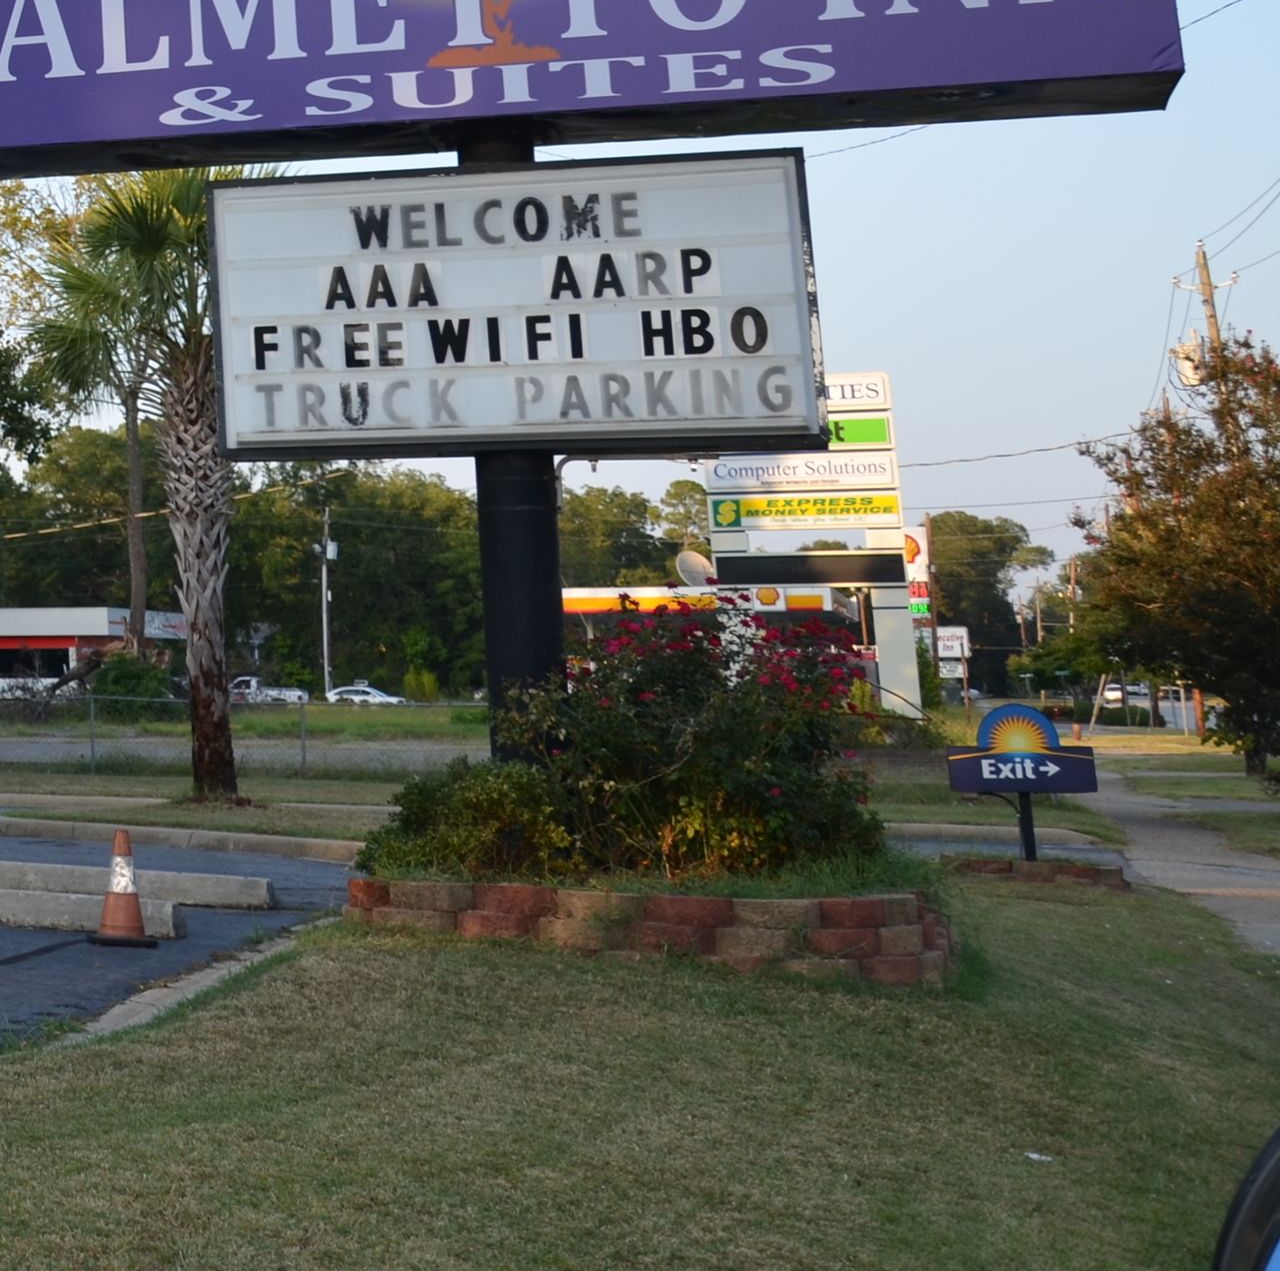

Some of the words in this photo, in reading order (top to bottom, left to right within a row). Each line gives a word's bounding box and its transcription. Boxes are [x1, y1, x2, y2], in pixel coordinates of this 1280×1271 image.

[159, 86, 263, 125] &
[304, 44, 836, 117] SUITES
[350, 193, 640, 249] WELCOME
[325, 263, 439, 310] AAA
[550, 249, 712, 301] AARP
[641, 307, 769, 357] HBO
[257, 380, 458, 428] TRUCK
[517, 367, 792, 418] PARKING
[825, 383, 879, 400] TIES
[713, 463, 799, 481] Computer
[804, 459, 886, 476] Solutions
[745, 507, 809, 517] MONEY
[816, 506, 893, 515] SERVICE
[766, 497, 874, 508] EXPRESS
[981, 757, 1037, 779] Exit
